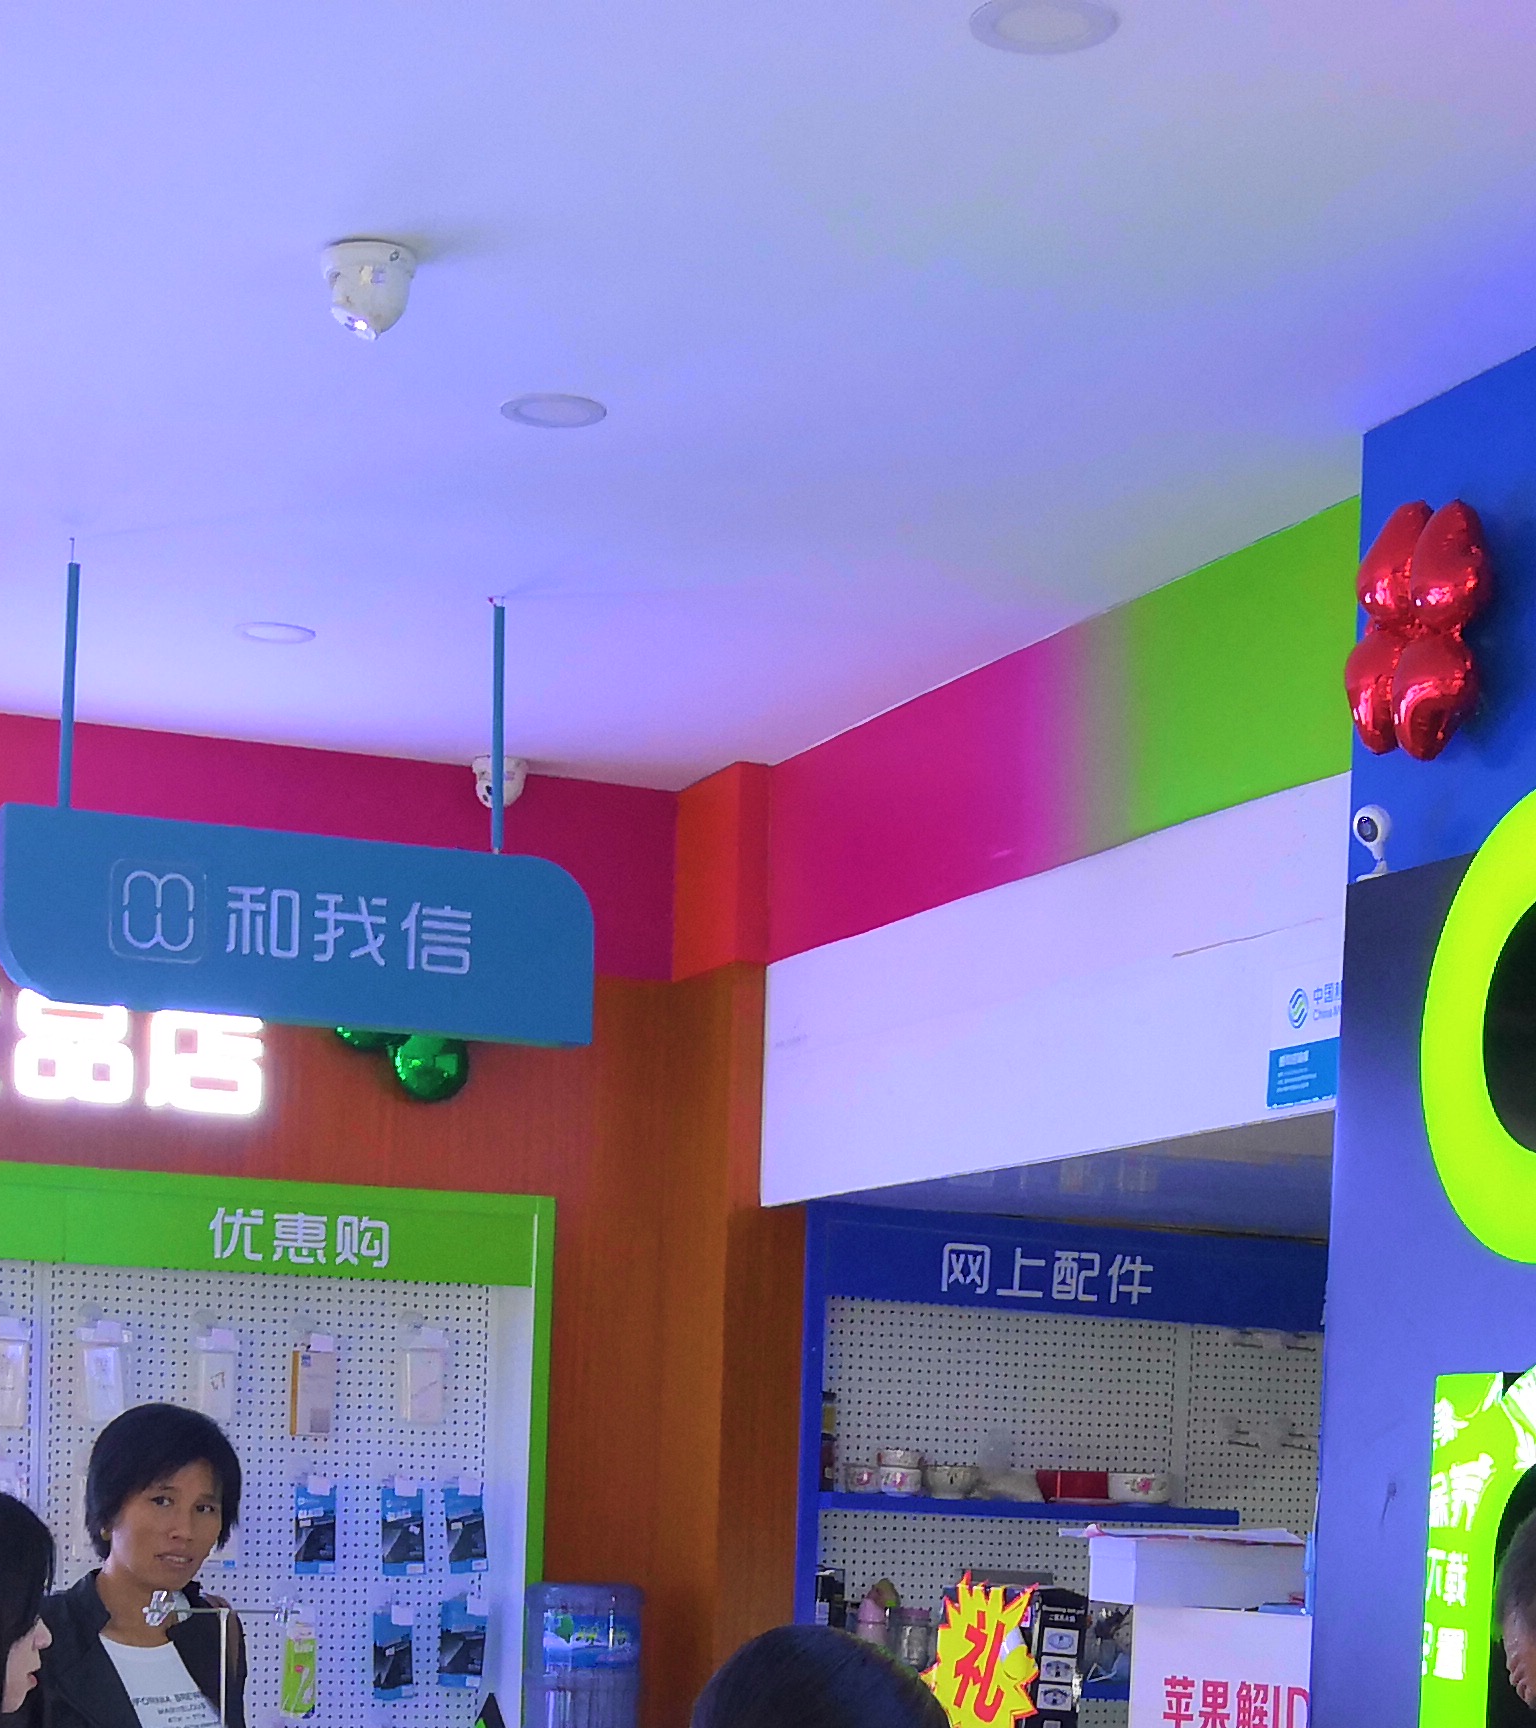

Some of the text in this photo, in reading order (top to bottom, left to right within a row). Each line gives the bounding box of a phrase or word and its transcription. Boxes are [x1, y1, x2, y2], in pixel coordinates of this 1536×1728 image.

[223, 883, 473, 976] 和我信
[209, 1205, 391, 1269] 优惠购
[941, 1241, 1155, 1306] 网上配件
[953, 1610, 1009, 1724] 礼
